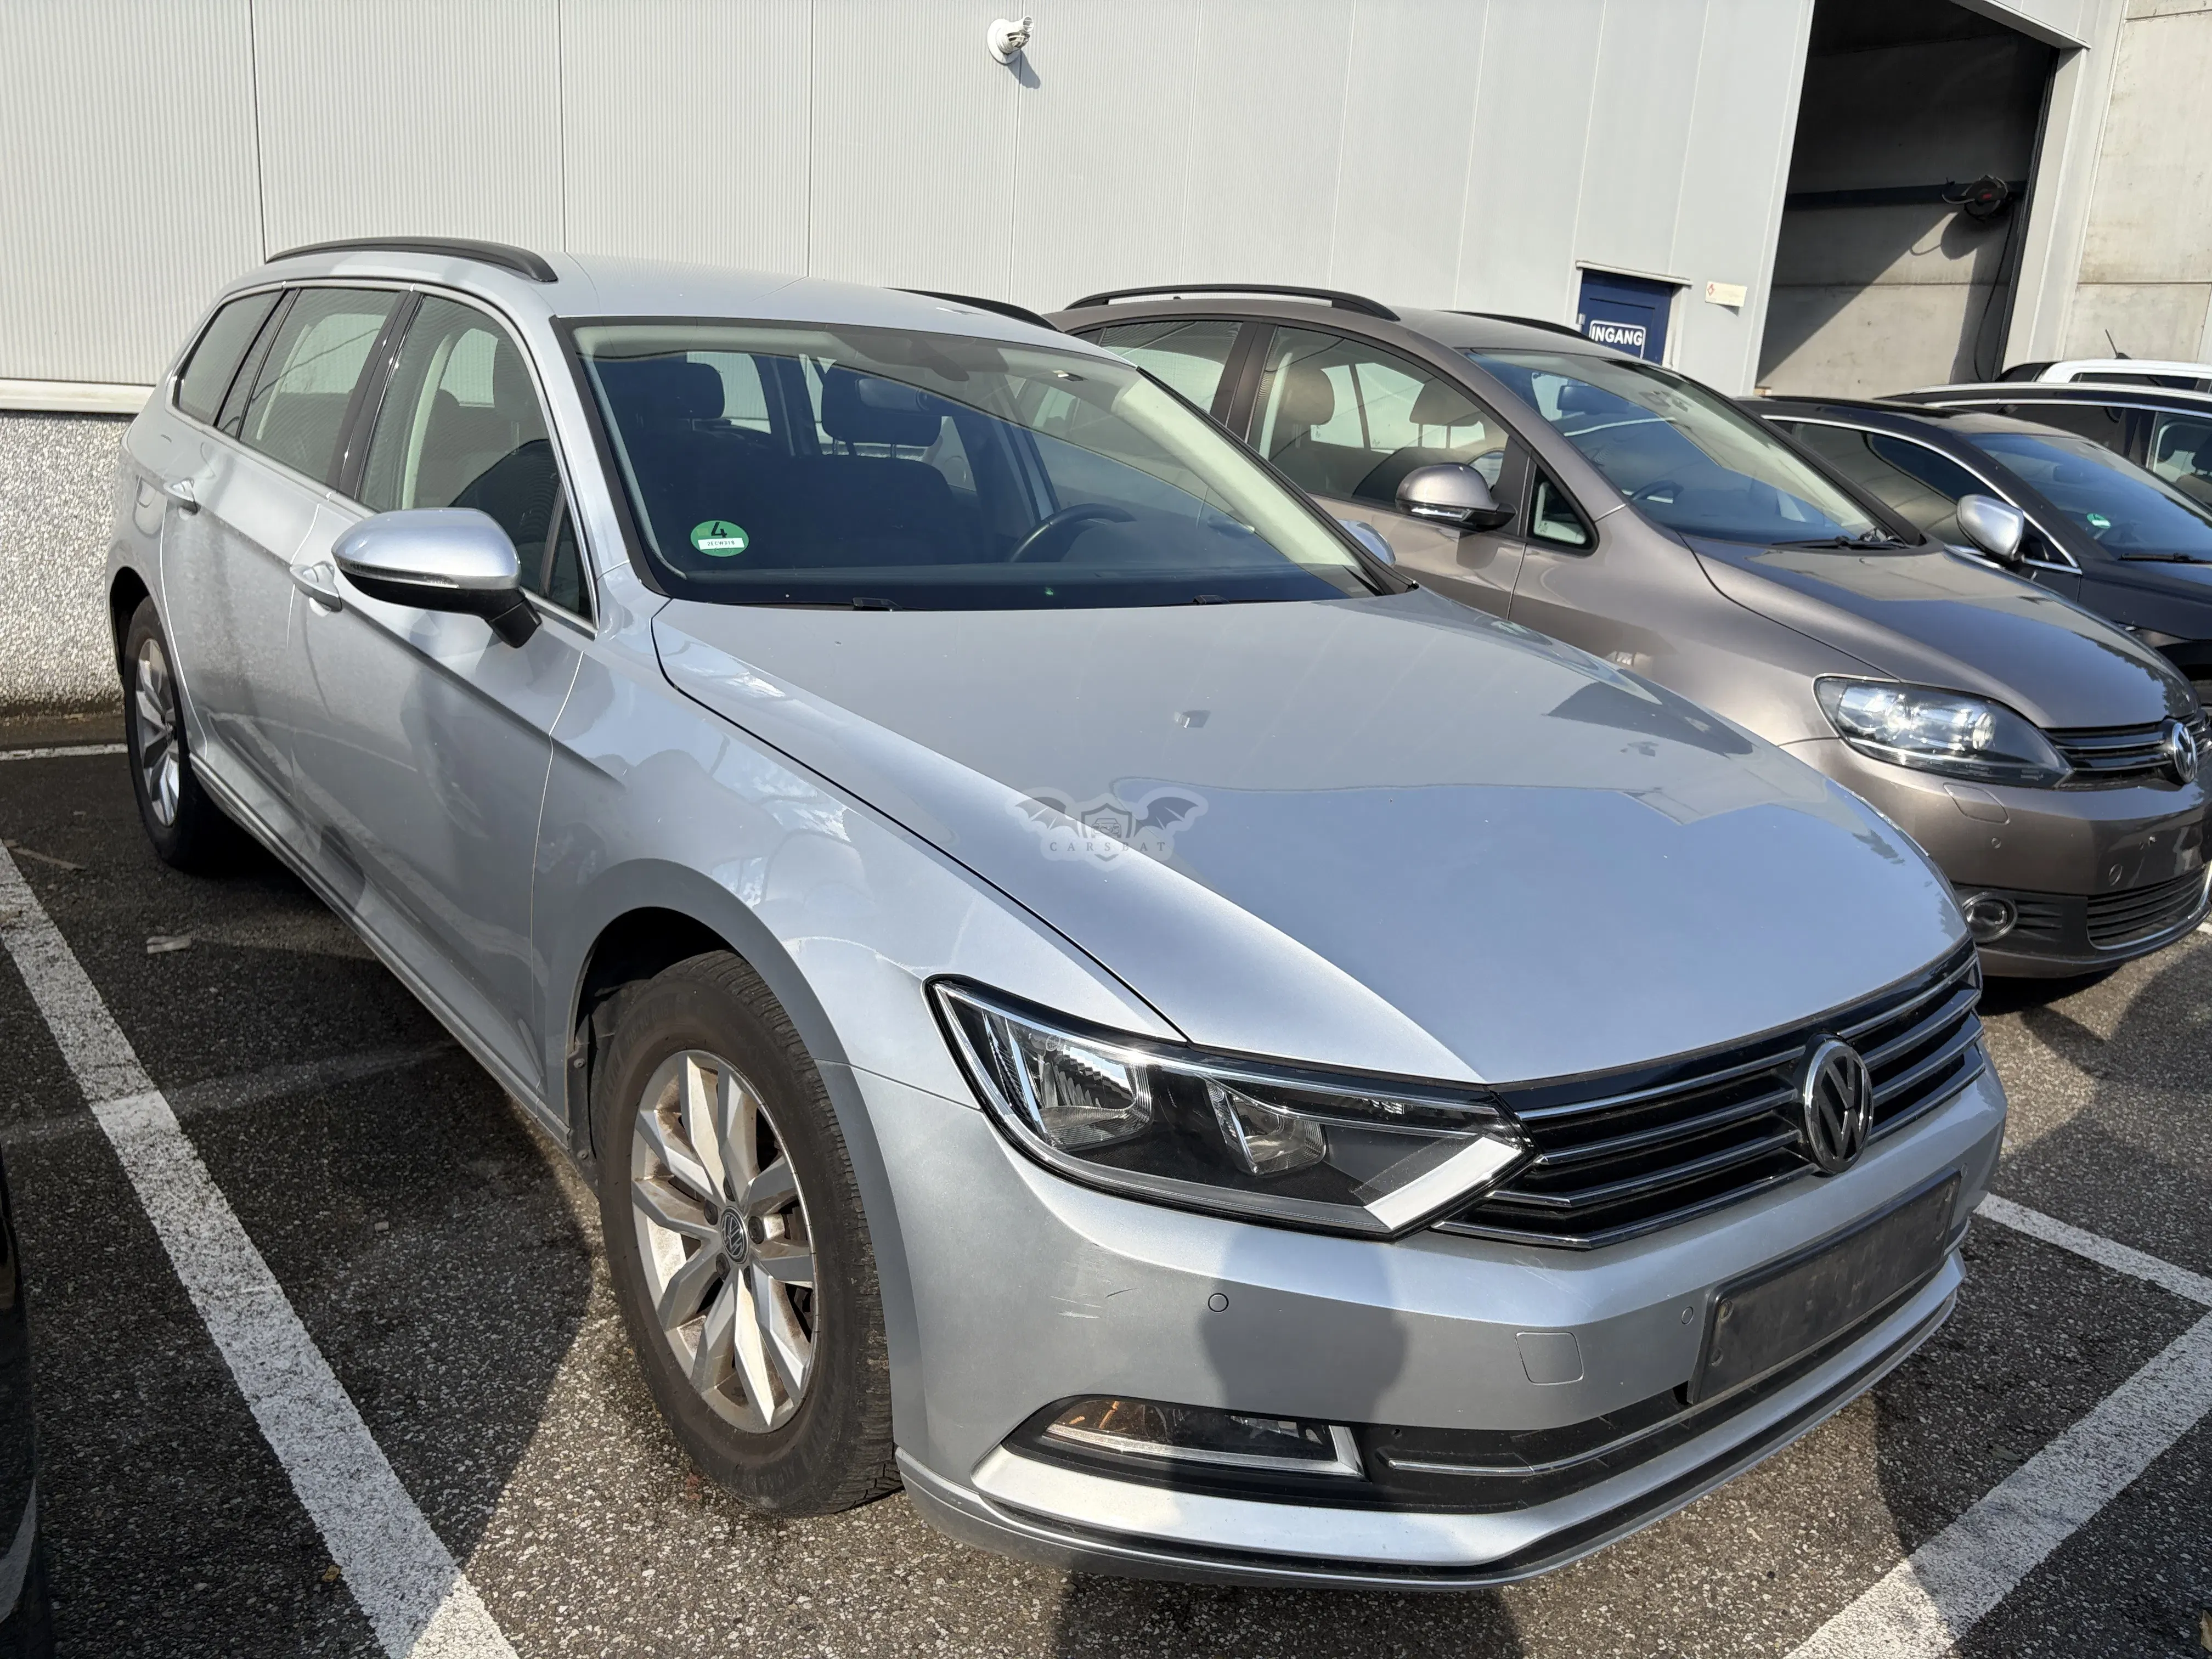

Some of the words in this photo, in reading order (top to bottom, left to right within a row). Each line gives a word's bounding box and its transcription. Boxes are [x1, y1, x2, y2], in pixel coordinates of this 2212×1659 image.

[1592, 325, 1643, 346] INGANG
[711, 522, 728, 538] 4
[1806, 1041, 1873, 1172] VW
